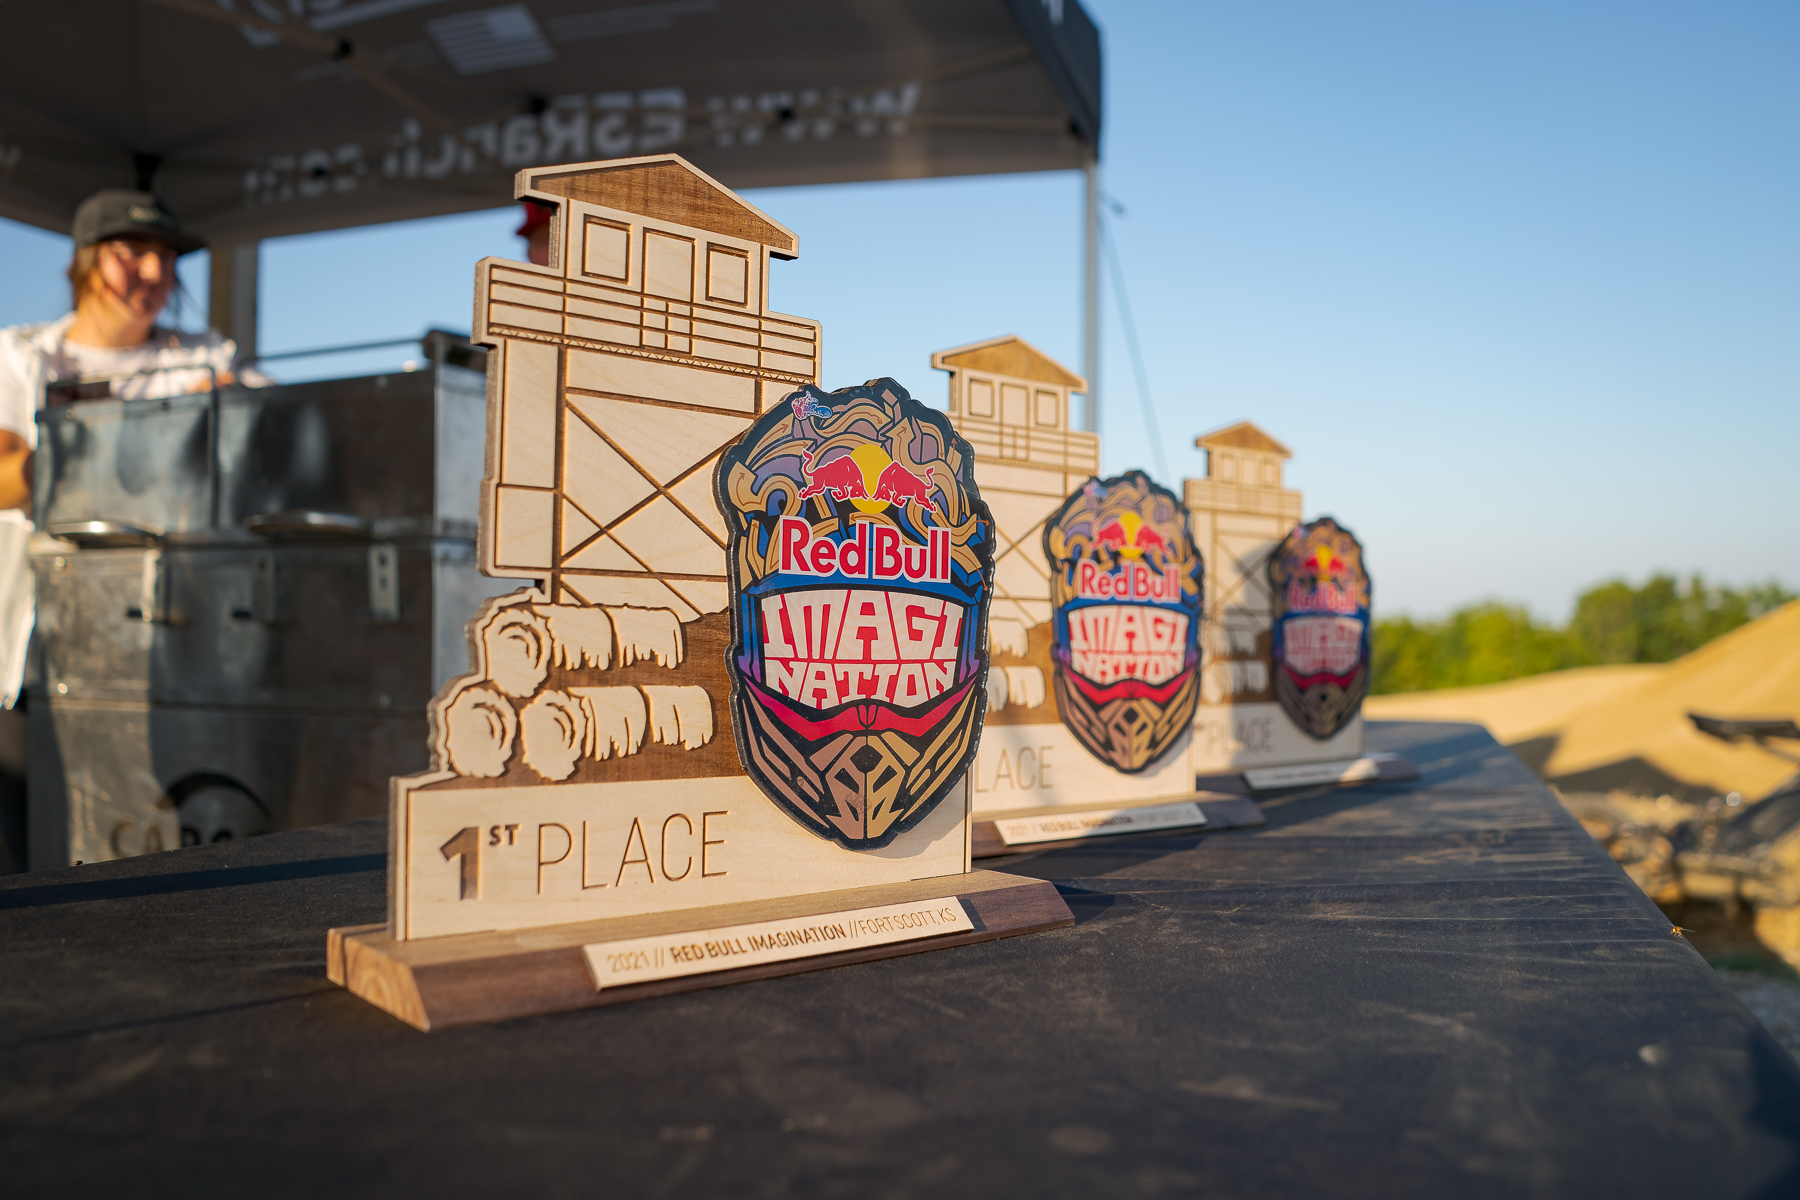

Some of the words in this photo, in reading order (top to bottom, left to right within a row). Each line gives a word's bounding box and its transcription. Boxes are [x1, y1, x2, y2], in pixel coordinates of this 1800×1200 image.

[780, 517, 868, 576] Red
[874, 525, 950, 581] Bull
[1080, 562, 1130, 597] Red
[1134, 565, 1181, 601] Bull
[761, 590, 964, 660] IMAGI
[765, 660, 957, 711] NATION
[974, 745, 1055, 794] LACE
[536, 809, 729, 896] PLACE
[607, 950, 649, 975] 2021
[669, 943, 704, 964] RED
[706, 937, 747, 959] BULL
[748, 923, 846, 953] IMAGINATION
